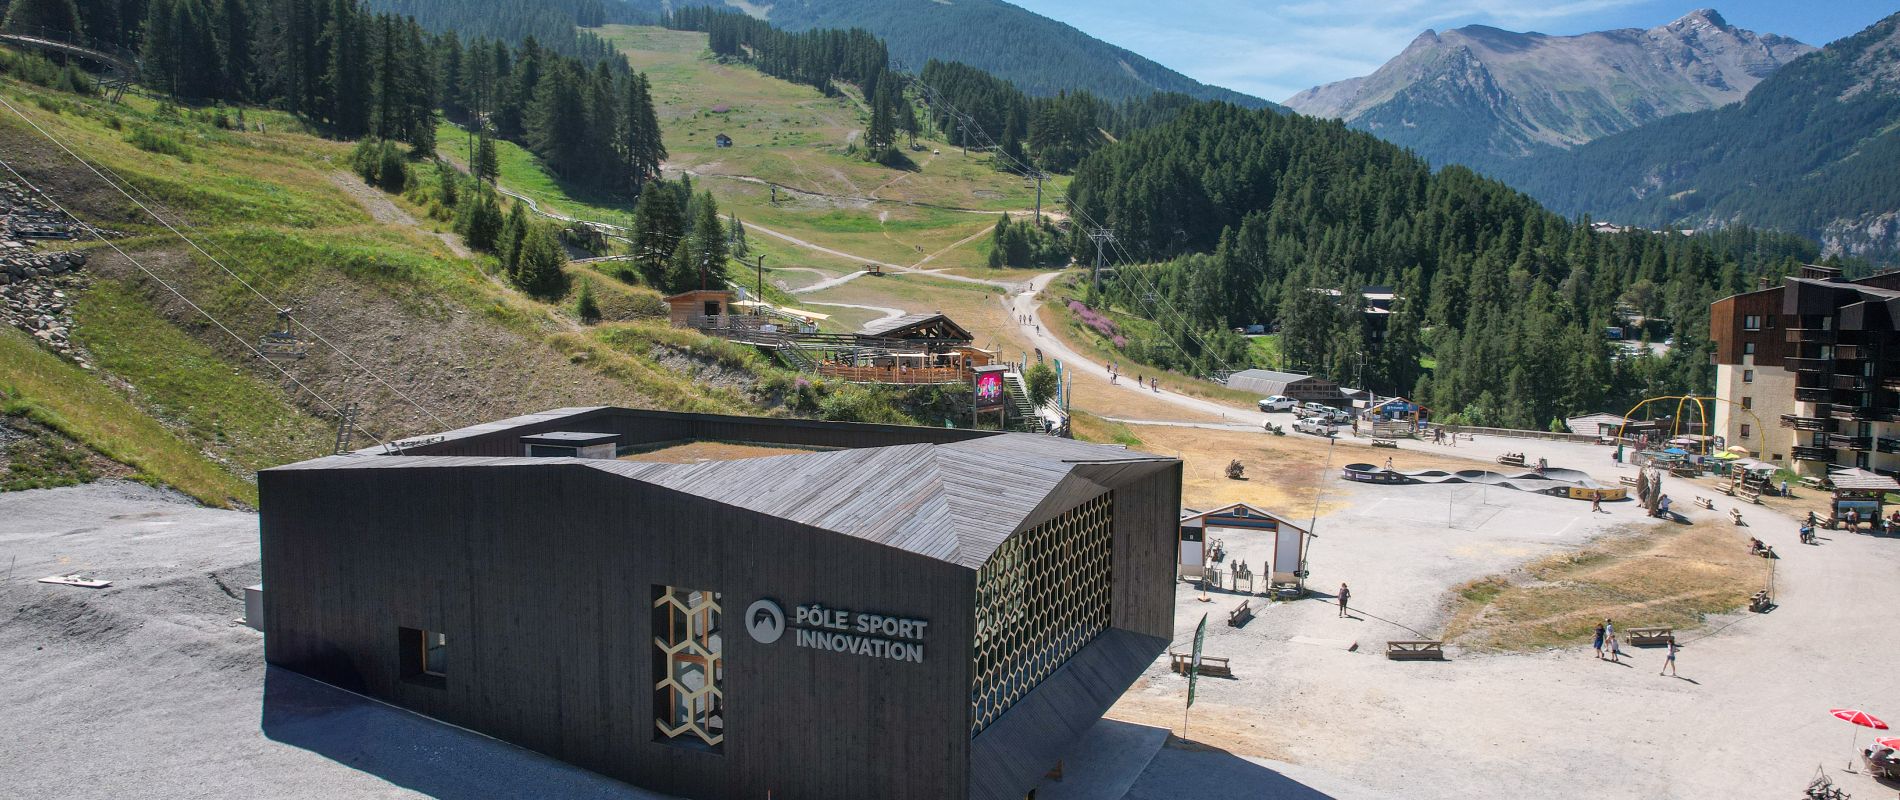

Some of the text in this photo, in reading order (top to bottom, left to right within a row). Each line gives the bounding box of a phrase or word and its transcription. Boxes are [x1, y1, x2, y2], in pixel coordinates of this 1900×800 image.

[796, 604, 928, 640] PÔLE SPORT
[797, 629, 924, 664] INNOVATION
